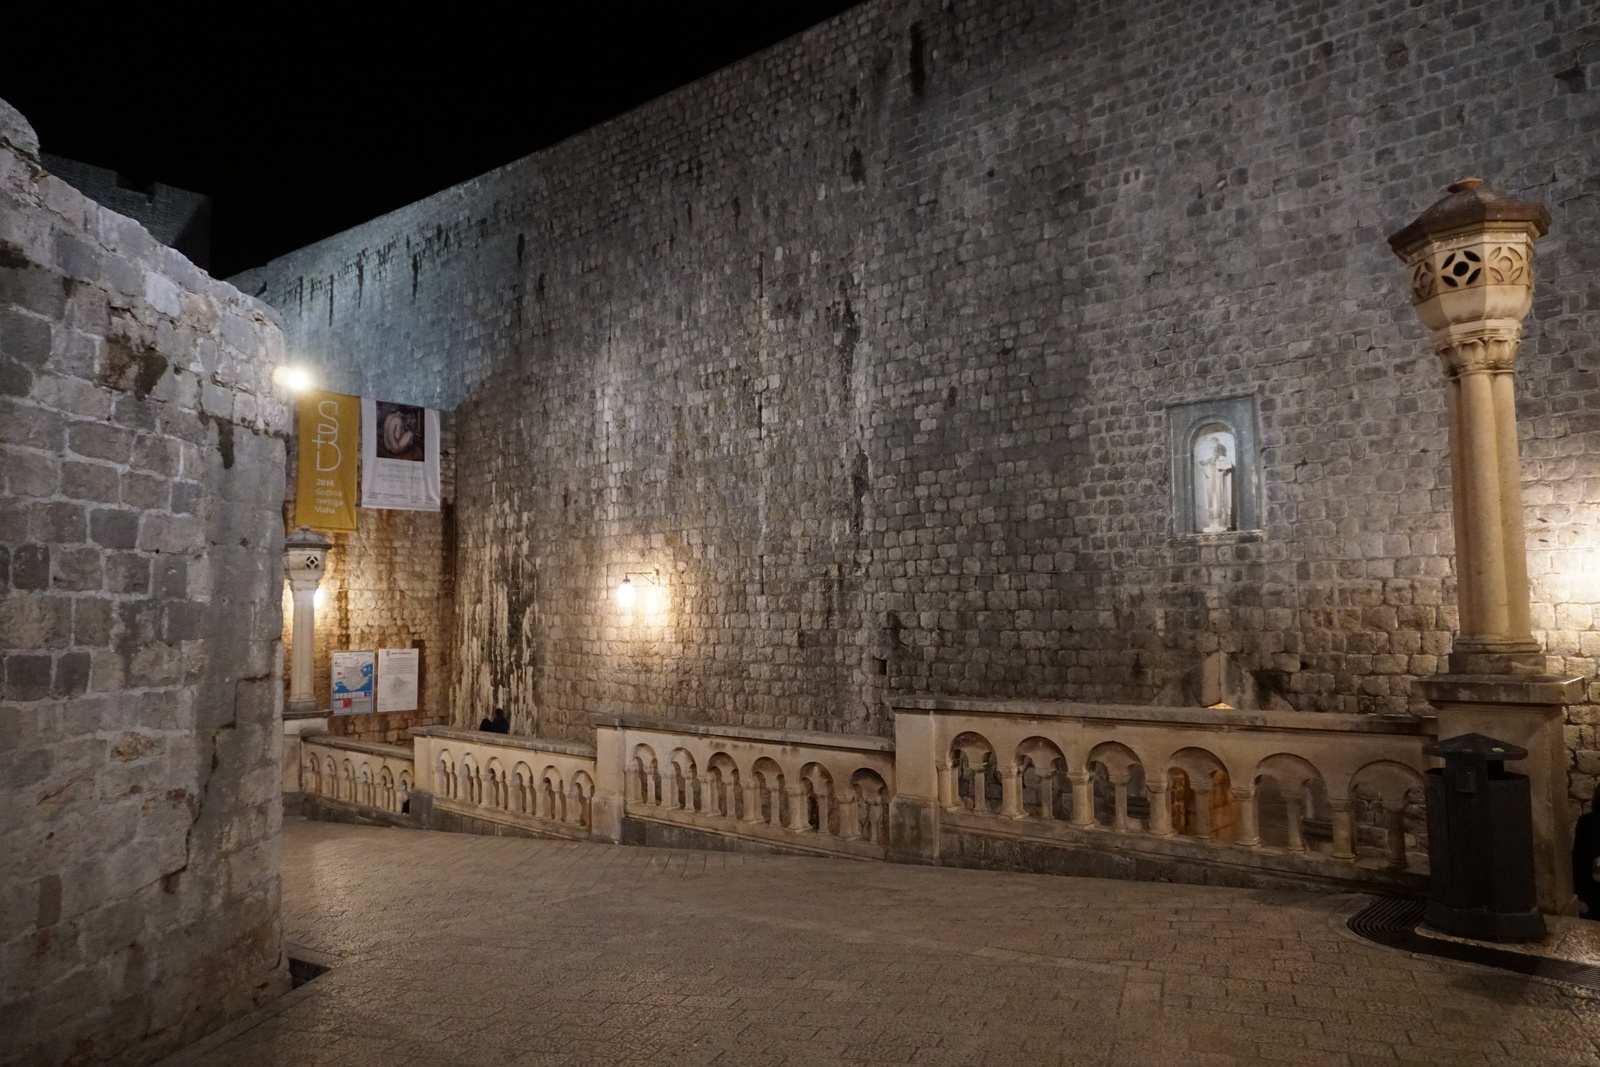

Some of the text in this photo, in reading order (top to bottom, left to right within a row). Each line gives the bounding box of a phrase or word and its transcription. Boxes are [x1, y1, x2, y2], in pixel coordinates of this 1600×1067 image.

[316, 478, 335, 487] 2016
[315, 488, 342, 497] Godina
[315, 498, 344, 507] svetoga
[314, 505, 336, 514] Vlaha
